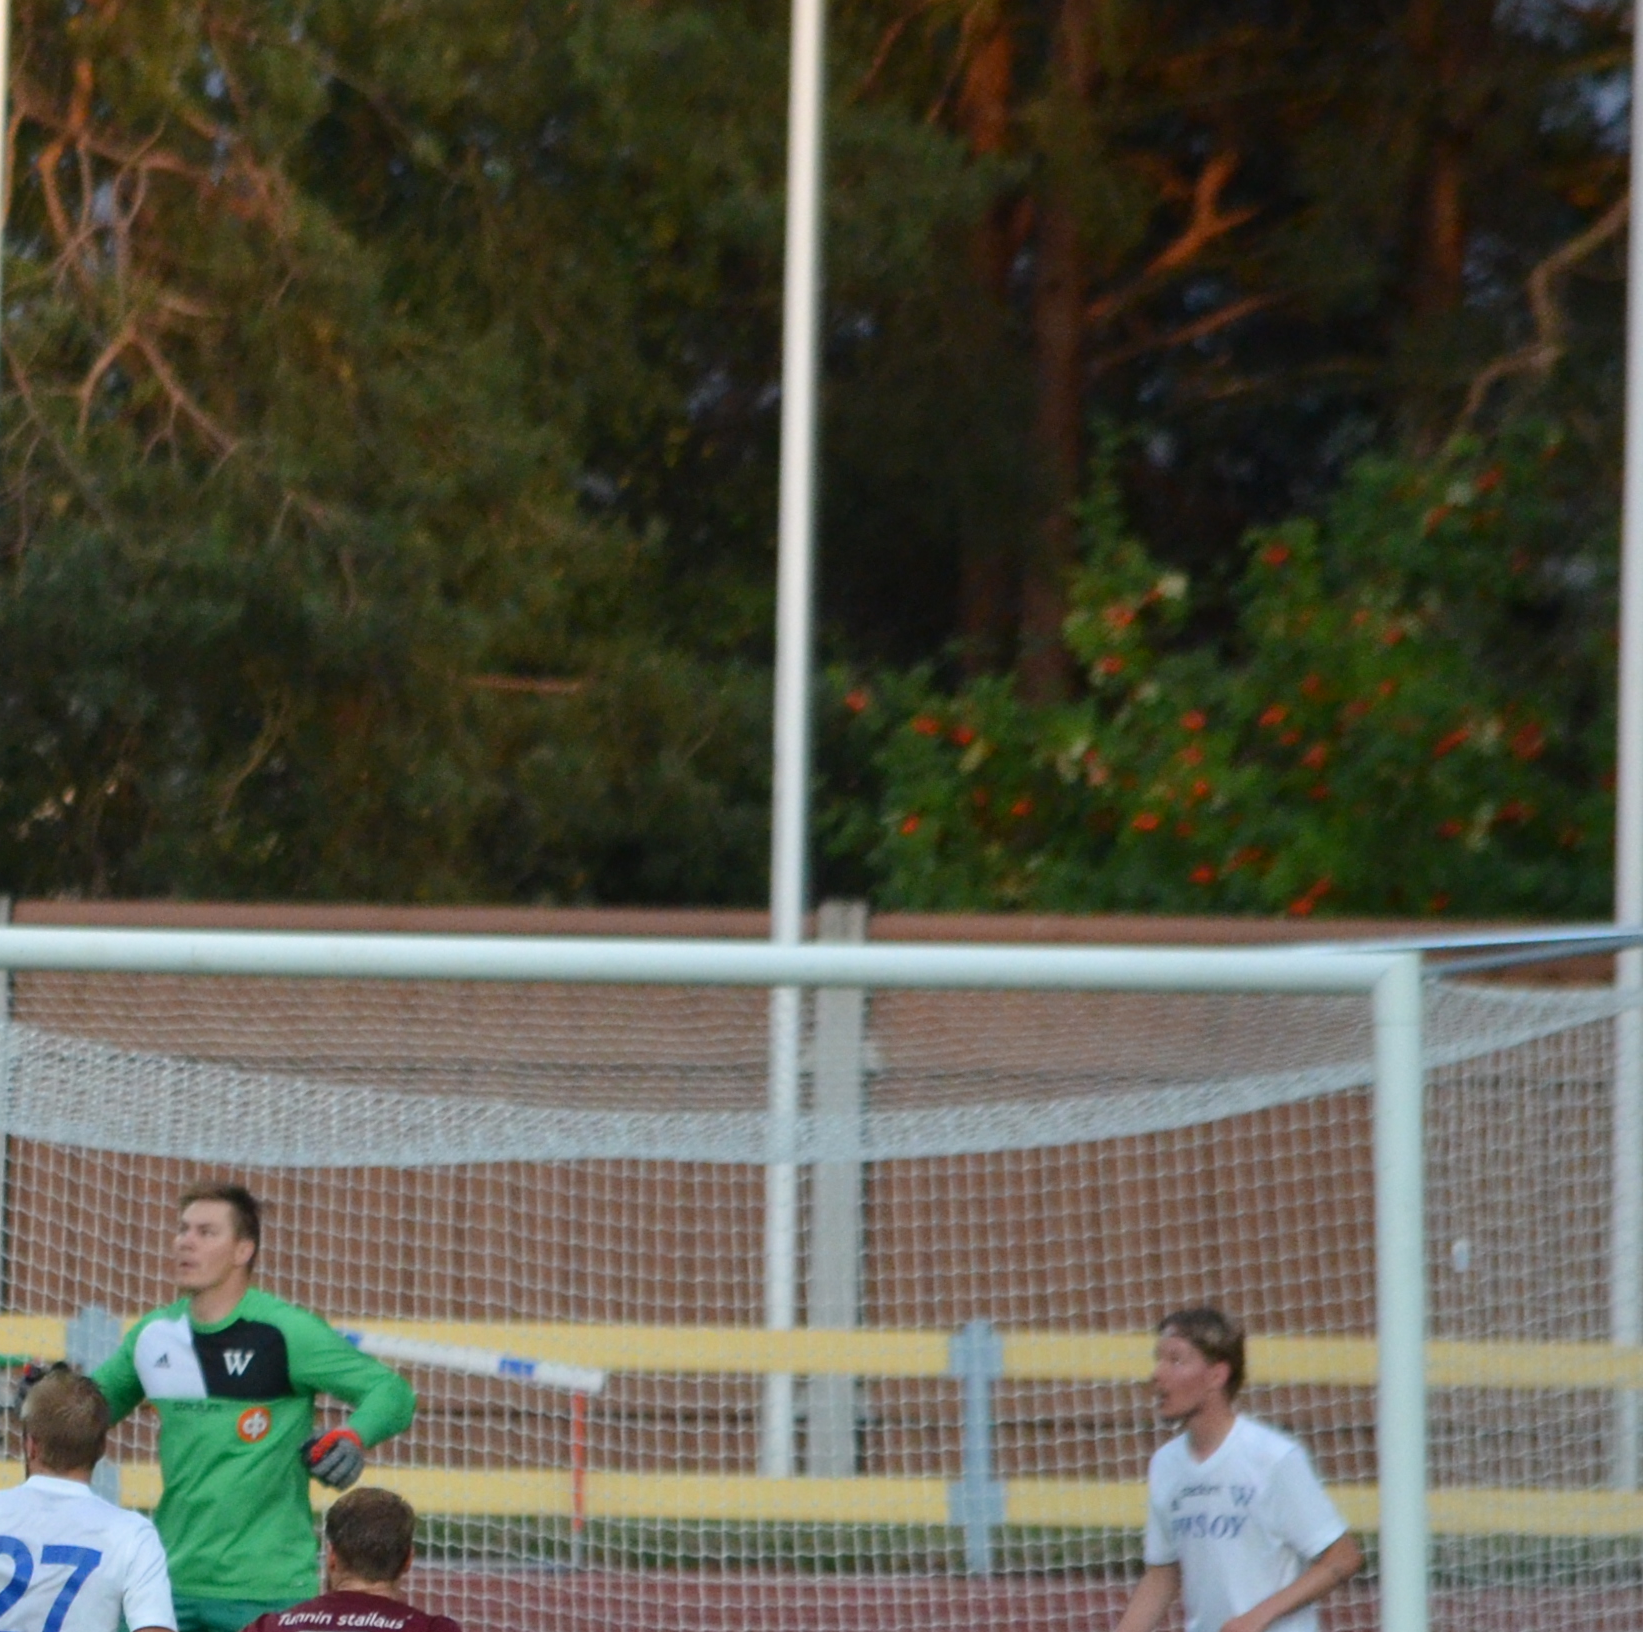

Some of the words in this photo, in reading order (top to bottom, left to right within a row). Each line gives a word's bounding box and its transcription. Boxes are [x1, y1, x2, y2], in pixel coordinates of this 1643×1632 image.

[223, 1349, 254, 1376] W
[278, 1609, 333, 1627] Tunnin
[336, 1611, 405, 1630] stailaus
